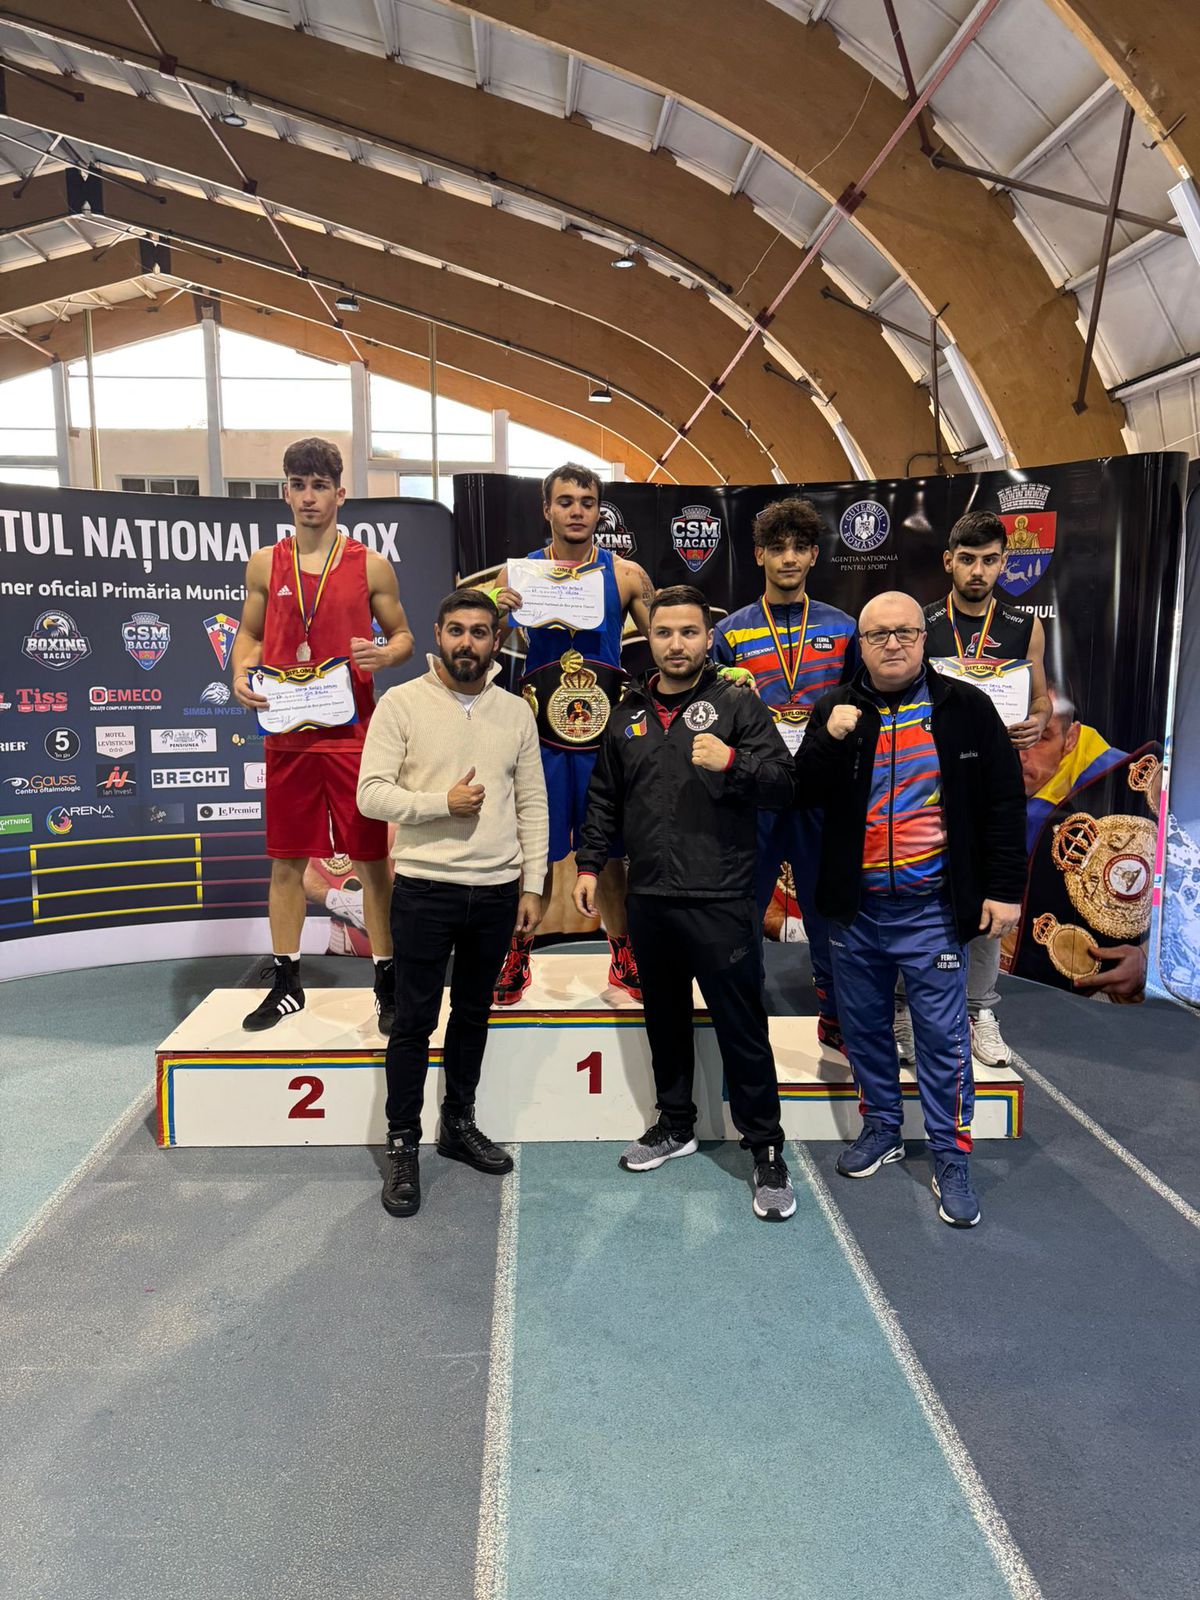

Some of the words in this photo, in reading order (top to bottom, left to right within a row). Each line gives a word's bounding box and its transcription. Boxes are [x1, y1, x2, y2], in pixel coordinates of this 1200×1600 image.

[845, 503, 886, 521] GUVERNUL
[0, 509, 73, 555] TUL
[673, 521, 719, 538] CSM
[336, 522, 401, 563] OX
[592, 533, 632, 548] XING
[867, 563, 888, 571] SPORT
[1, 582, 33, 595] ner
[38, 580, 97, 598] oficial
[102, 582, 181, 600] Primăria
[186, 585, 249, 601] Munici
[1014, 605, 1056, 618] PIUL
[123, 626, 168, 641] CSM
[26, 638, 88, 651] BOXING
[16, 688, 68, 704] Tiss
[92, 689, 162, 702] DEMECO
[183, 707, 213, 716] SIMBA
[215, 706, 247, 715] INVEST
[55, 731, 70, 751] 5
[31, 775, 77, 789] Gauss
[153, 770, 228, 785] BRECHT
[39, 786, 81, 794] oftalmologic
[58, 805, 114, 817] ARENA
[228, 806, 260, 815] Premier
[576, 1051, 602, 1095] 1
[287, 1075, 325, 1119] 2
